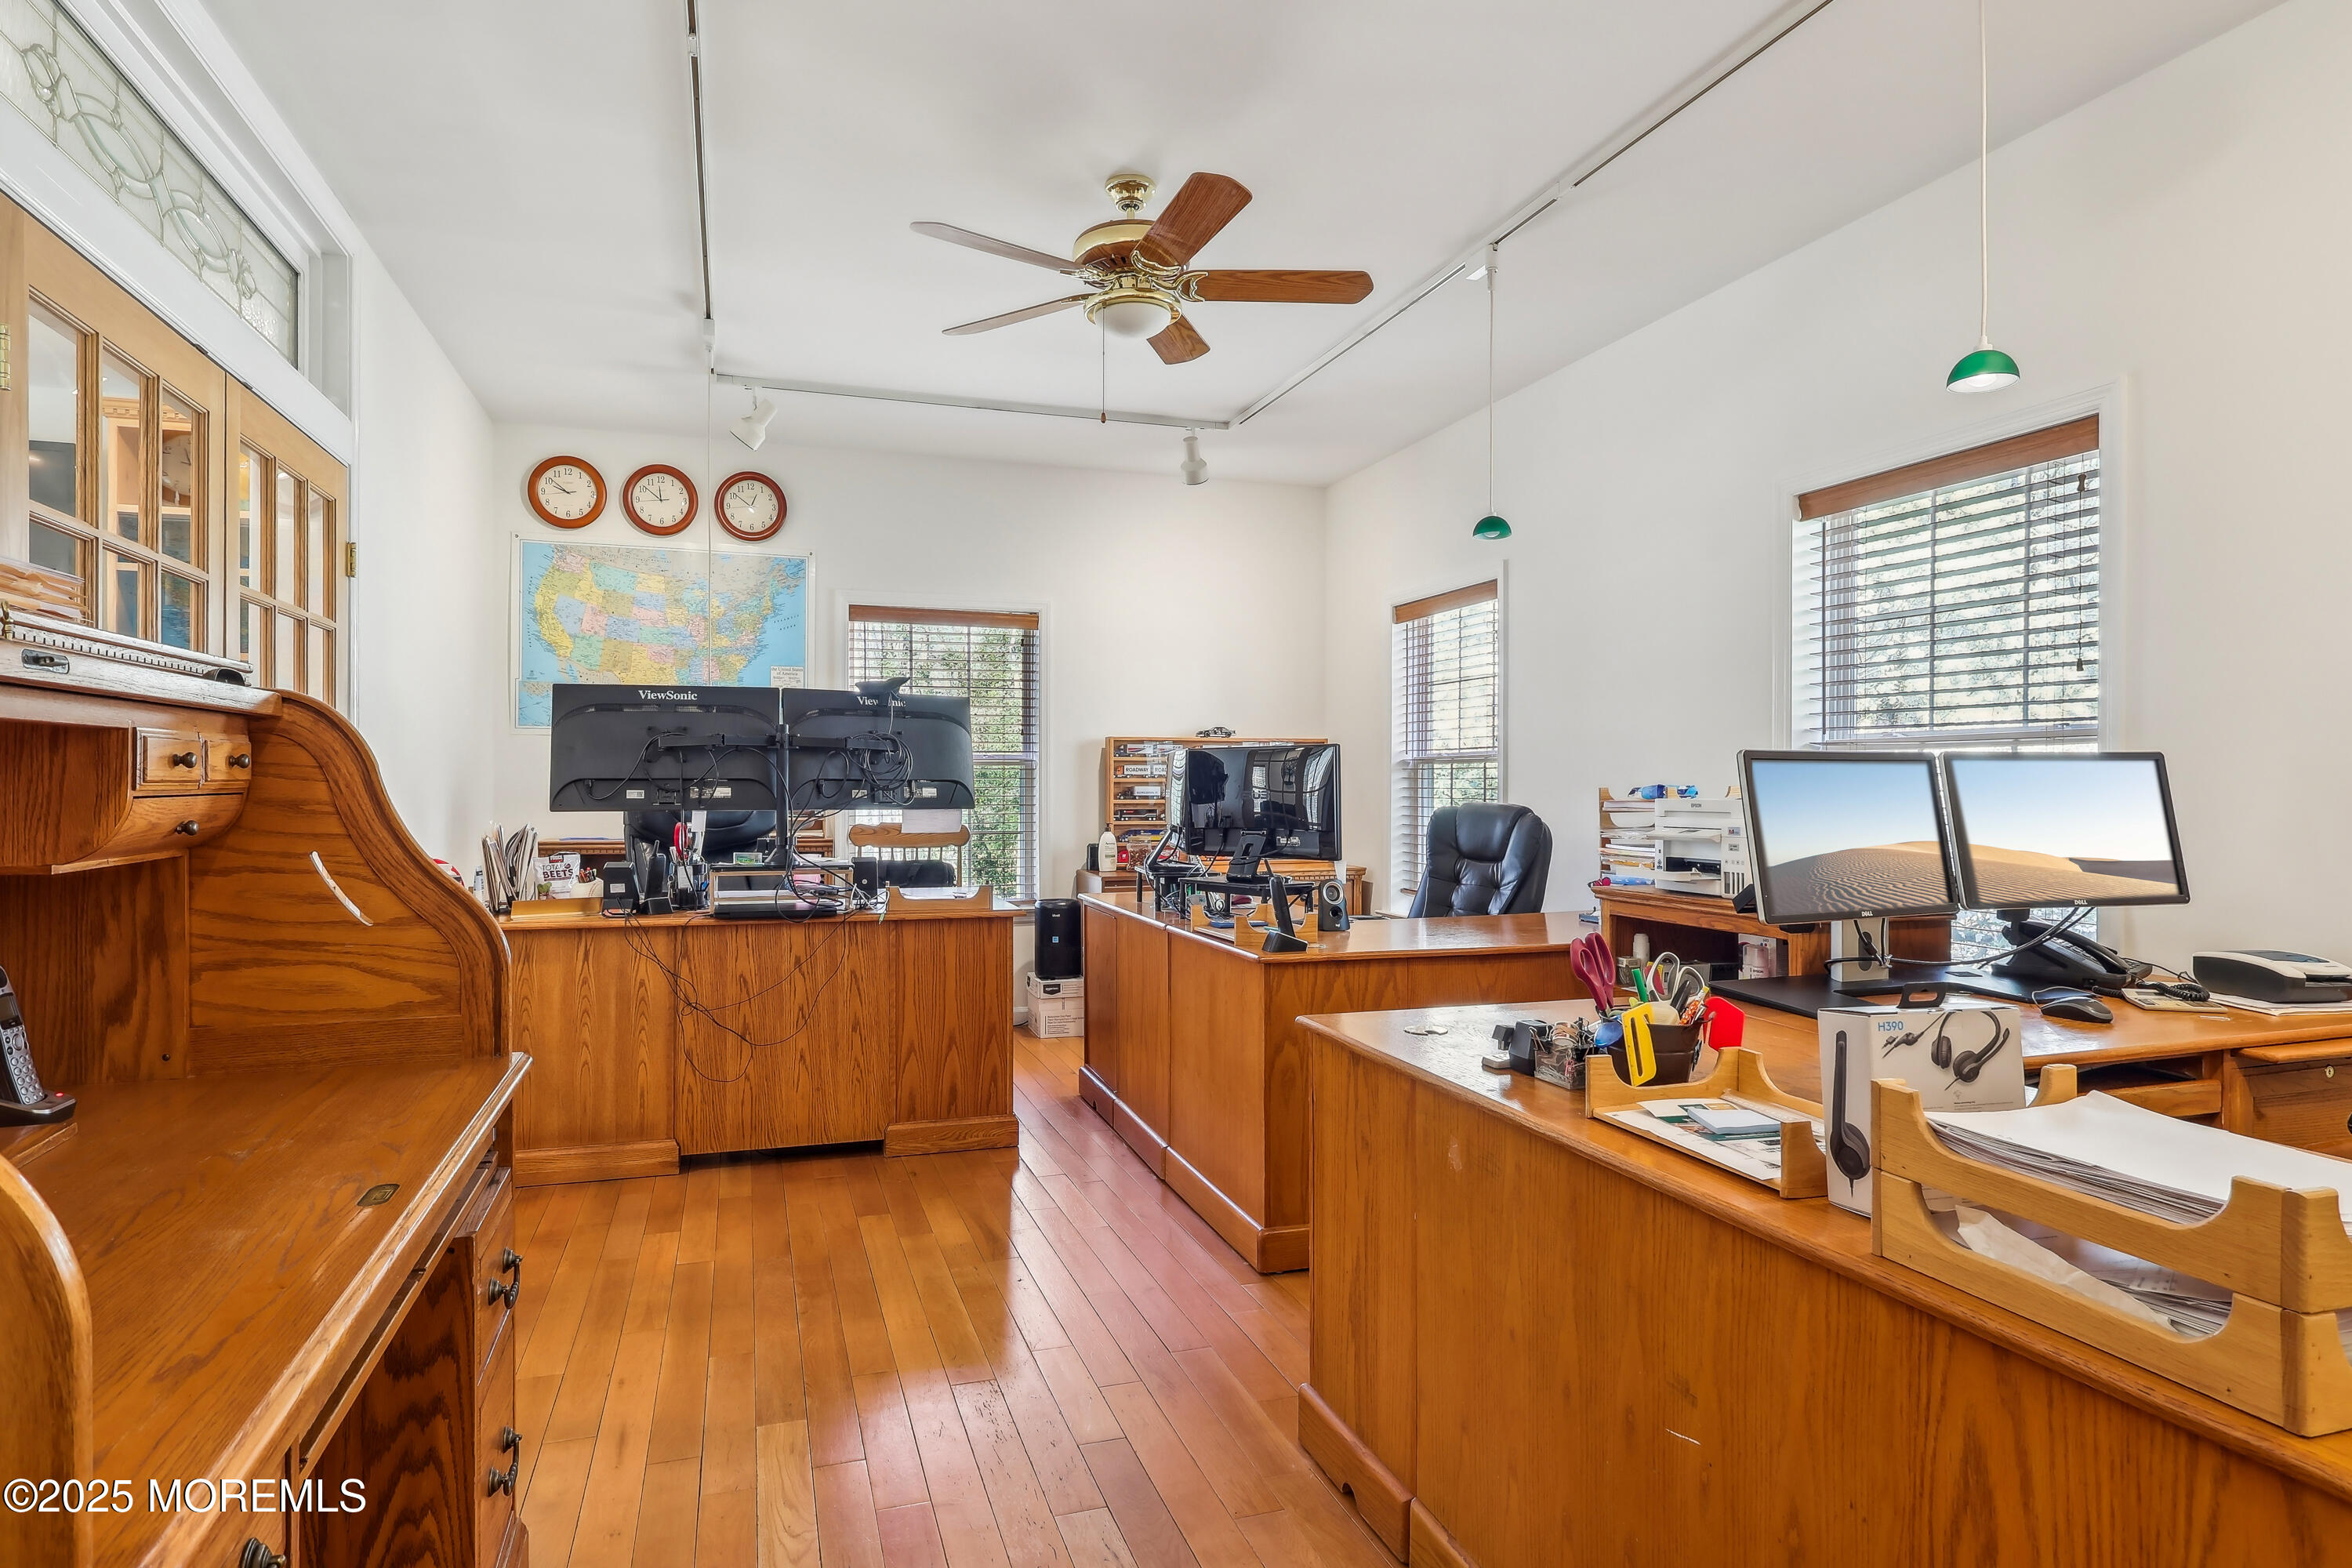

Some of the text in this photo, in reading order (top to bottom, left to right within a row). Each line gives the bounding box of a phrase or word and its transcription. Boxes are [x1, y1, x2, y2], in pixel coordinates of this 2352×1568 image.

[638, 690, 698, 700] ViewSonic
[857, 695, 907, 707] Viewnic
[543, 869, 573, 878] BEETS
[1878, 1021, 1904, 1031] H390
